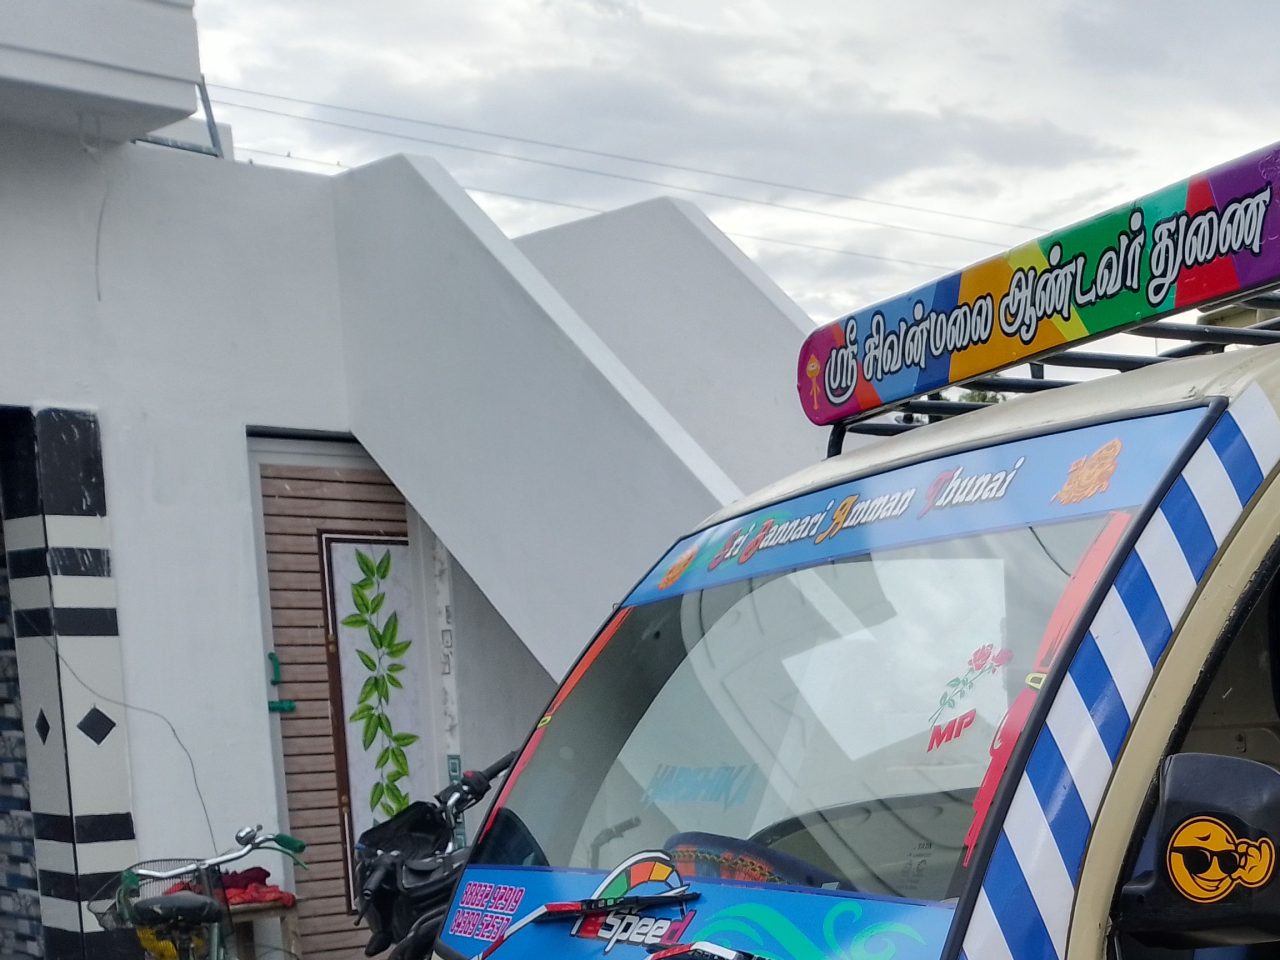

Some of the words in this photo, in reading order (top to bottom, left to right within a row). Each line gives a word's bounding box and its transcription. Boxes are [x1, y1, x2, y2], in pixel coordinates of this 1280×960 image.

[862, 292, 995, 382] சிவன்மலை
[999, 209, 1147, 345] ஆண்டவர்
[1147, 181, 1273, 306] துணை
[814, 487, 917, 545] Amman
[917, 456, 1026, 520] Thunai
[927, 708, 977, 753] MP
